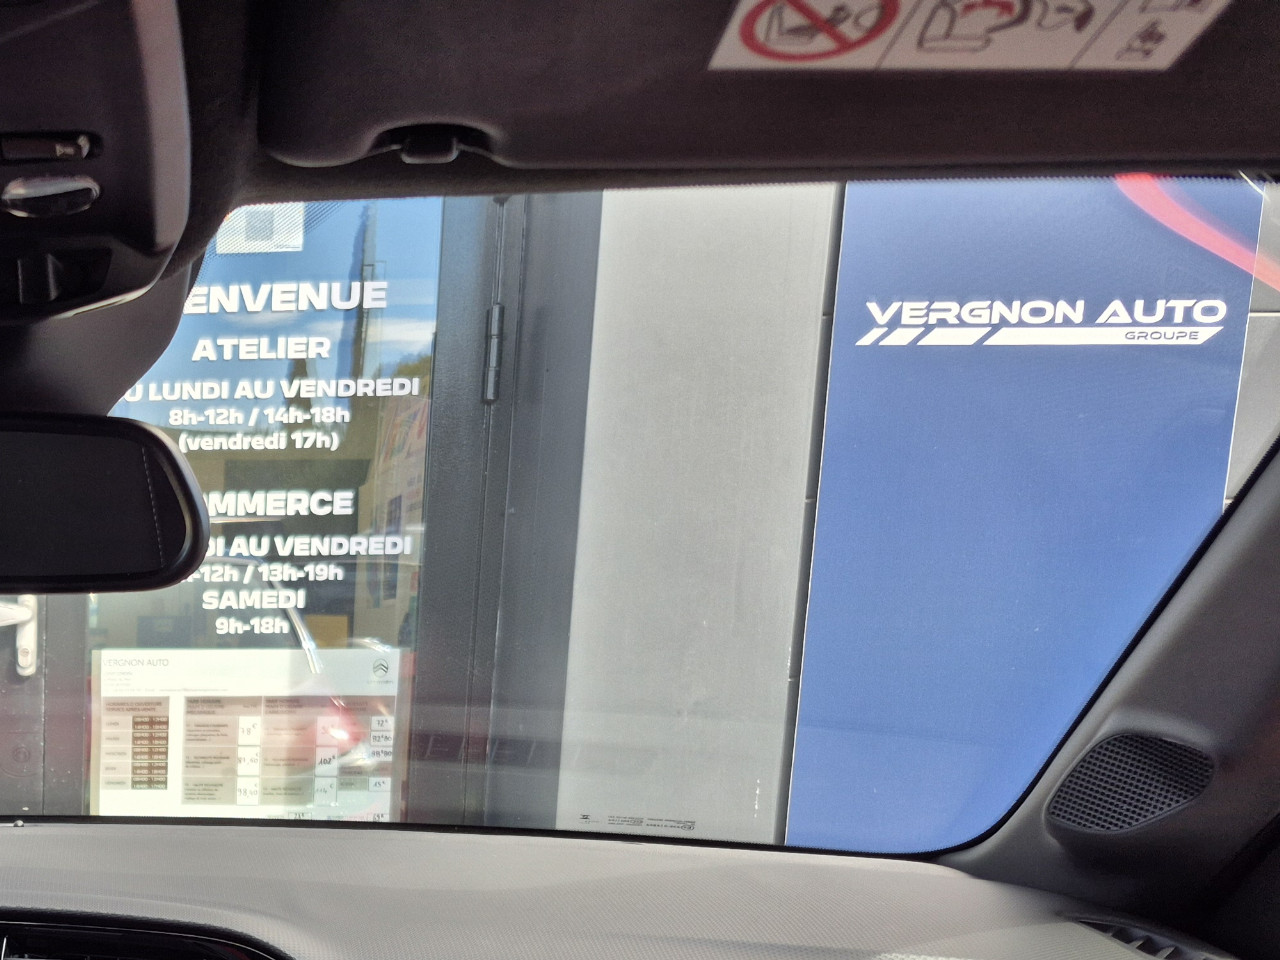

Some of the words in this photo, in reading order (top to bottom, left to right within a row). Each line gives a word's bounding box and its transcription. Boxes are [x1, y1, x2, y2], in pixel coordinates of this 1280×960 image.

[183, 281, 388, 314] ENVENUE
[865, 299, 1085, 325] VERGNON
[1095, 298, 1227, 324] AUTO
[1125, 331, 1200, 341] GROUPE
[191, 336, 332, 362] ATELIER
[124, 383, 144, 402] U
[148, 380, 229, 402] LUNDI
[233, 379, 275, 400] AU
[280, 377, 420, 398] VENDREDI
[169, 407, 243, 426] 8h-12h
[263, 405, 350, 424] 14h-18h
[178, 430, 288, 454] (vendredi
[290, 430, 340, 452] 17h)
[203, 490, 355, 517] MMERCE
[228, 535, 270, 557] AU
[274, 534, 413, 557] VENDREDI
[258, 562, 345, 582] 13h-19h
[201, 588, 307, 610] SAMEDI
[214, 615, 291, 635] 9h-18h
[103, 658, 145, 667] VERGNON
[147, 658, 169, 667] AUTO
